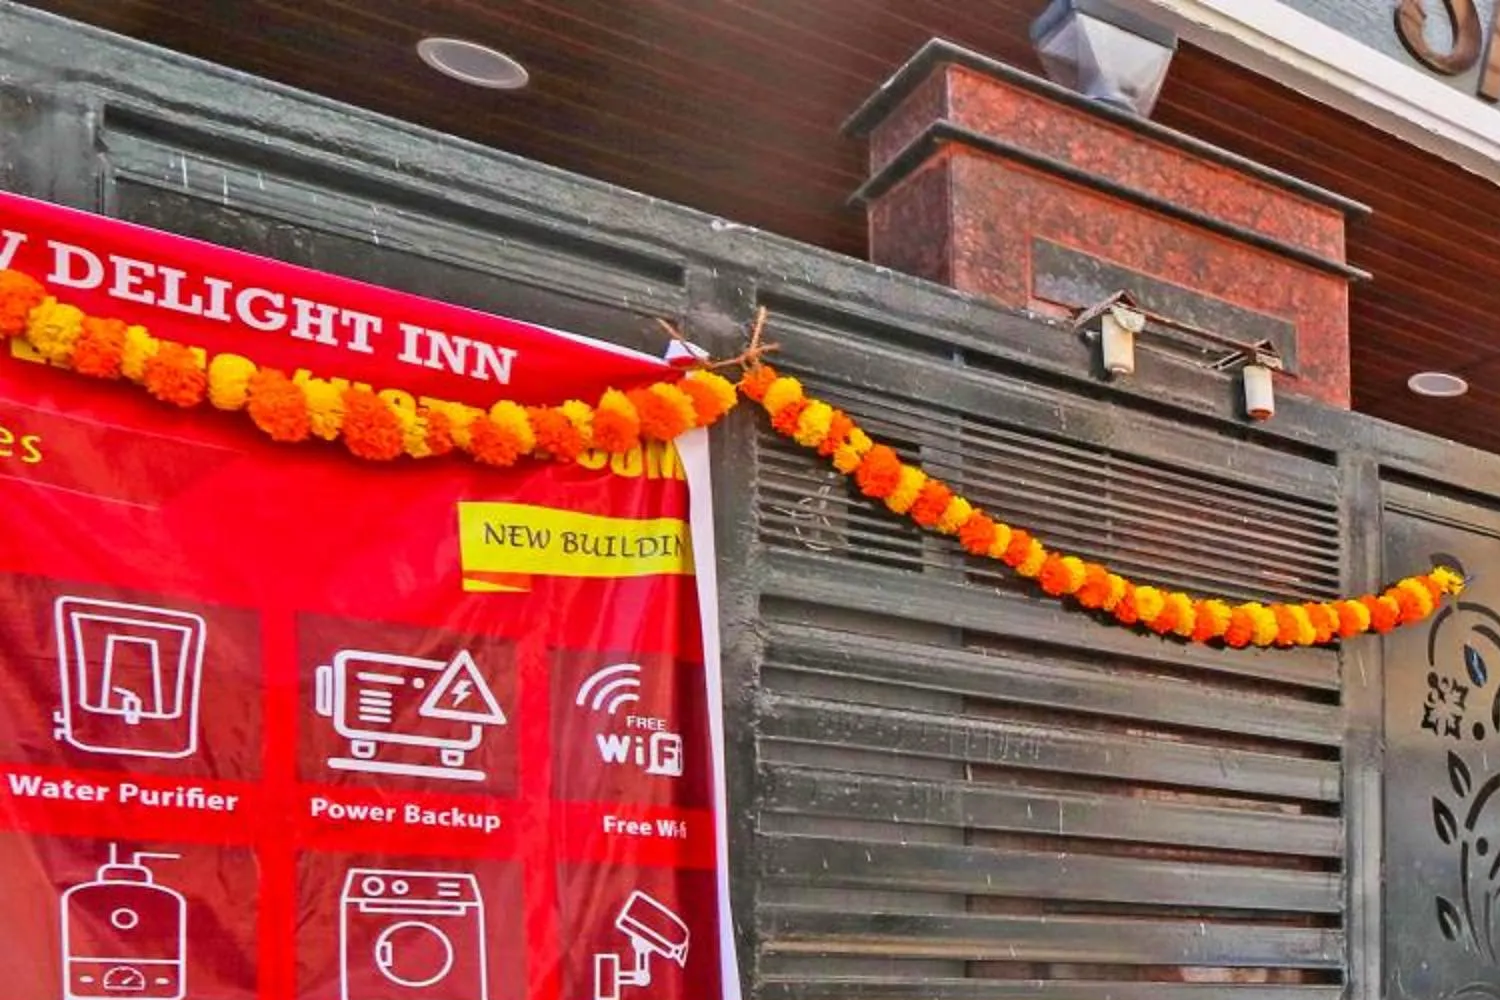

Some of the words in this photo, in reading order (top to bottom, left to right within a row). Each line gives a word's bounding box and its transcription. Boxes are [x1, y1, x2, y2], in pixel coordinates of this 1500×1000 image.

[47, 239, 382, 354] DELIGHT
[397, 322, 518, 385] INN
[483, 521, 551, 550] NEW
[626, 715, 667, 731] FREE
[8, 773, 110, 802] Water
[119, 782, 239, 811] Purifier
[310, 797, 397, 822] Power
[404, 803, 501, 833] Backup
[603, 815, 652, 836] Free
